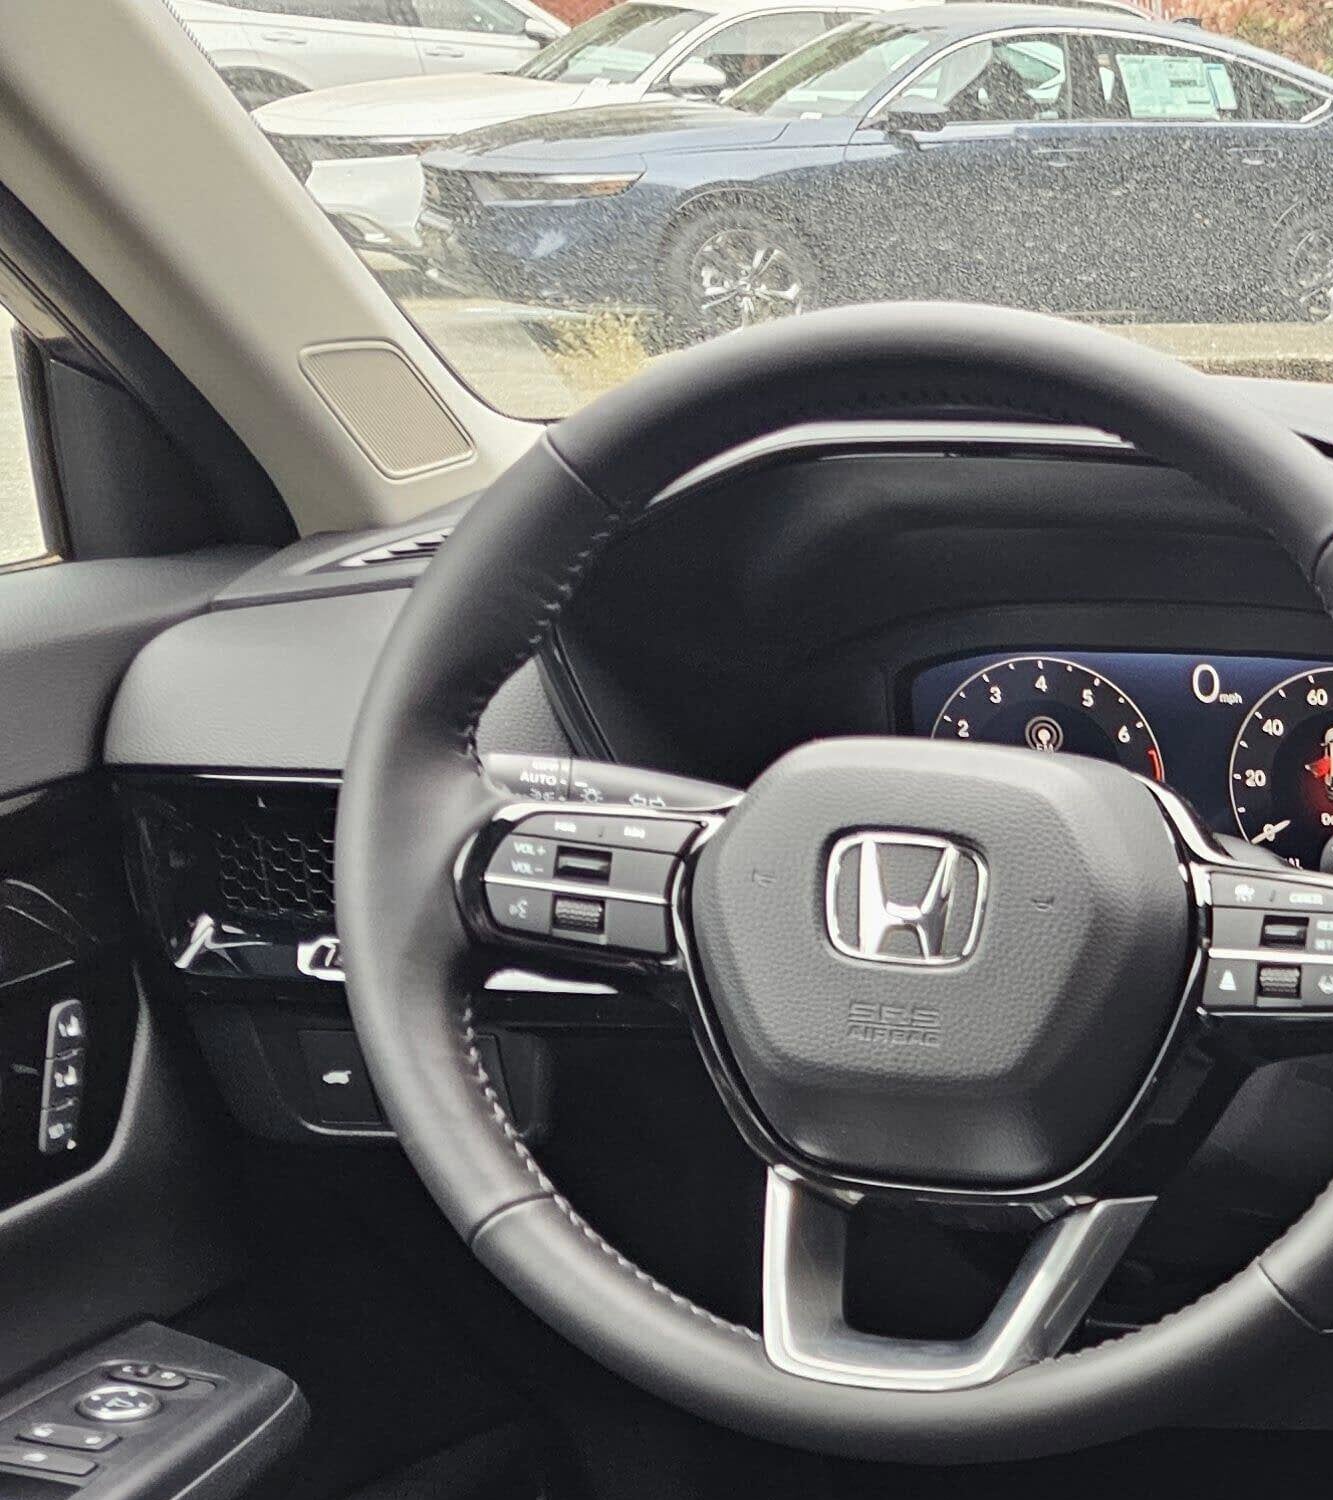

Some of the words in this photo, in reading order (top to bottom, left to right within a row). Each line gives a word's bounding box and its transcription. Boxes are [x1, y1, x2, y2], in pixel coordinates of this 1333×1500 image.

[1035, 675, 1047, 692] 4
[1193, 664, 1220, 704] 0
[1219, 693, 1243, 704] mph
[990, 686, 1002, 704] 3
[1082, 689, 1094, 707] 5
[1307, 689, 1328, 706] 60
[957, 719, 969, 738] 2
[1118, 725, 1131, 743] 6
[1262, 719, 1284, 737] 40
[520, 771, 557, 786] AUTO
[1244, 769, 1266, 787] 20
